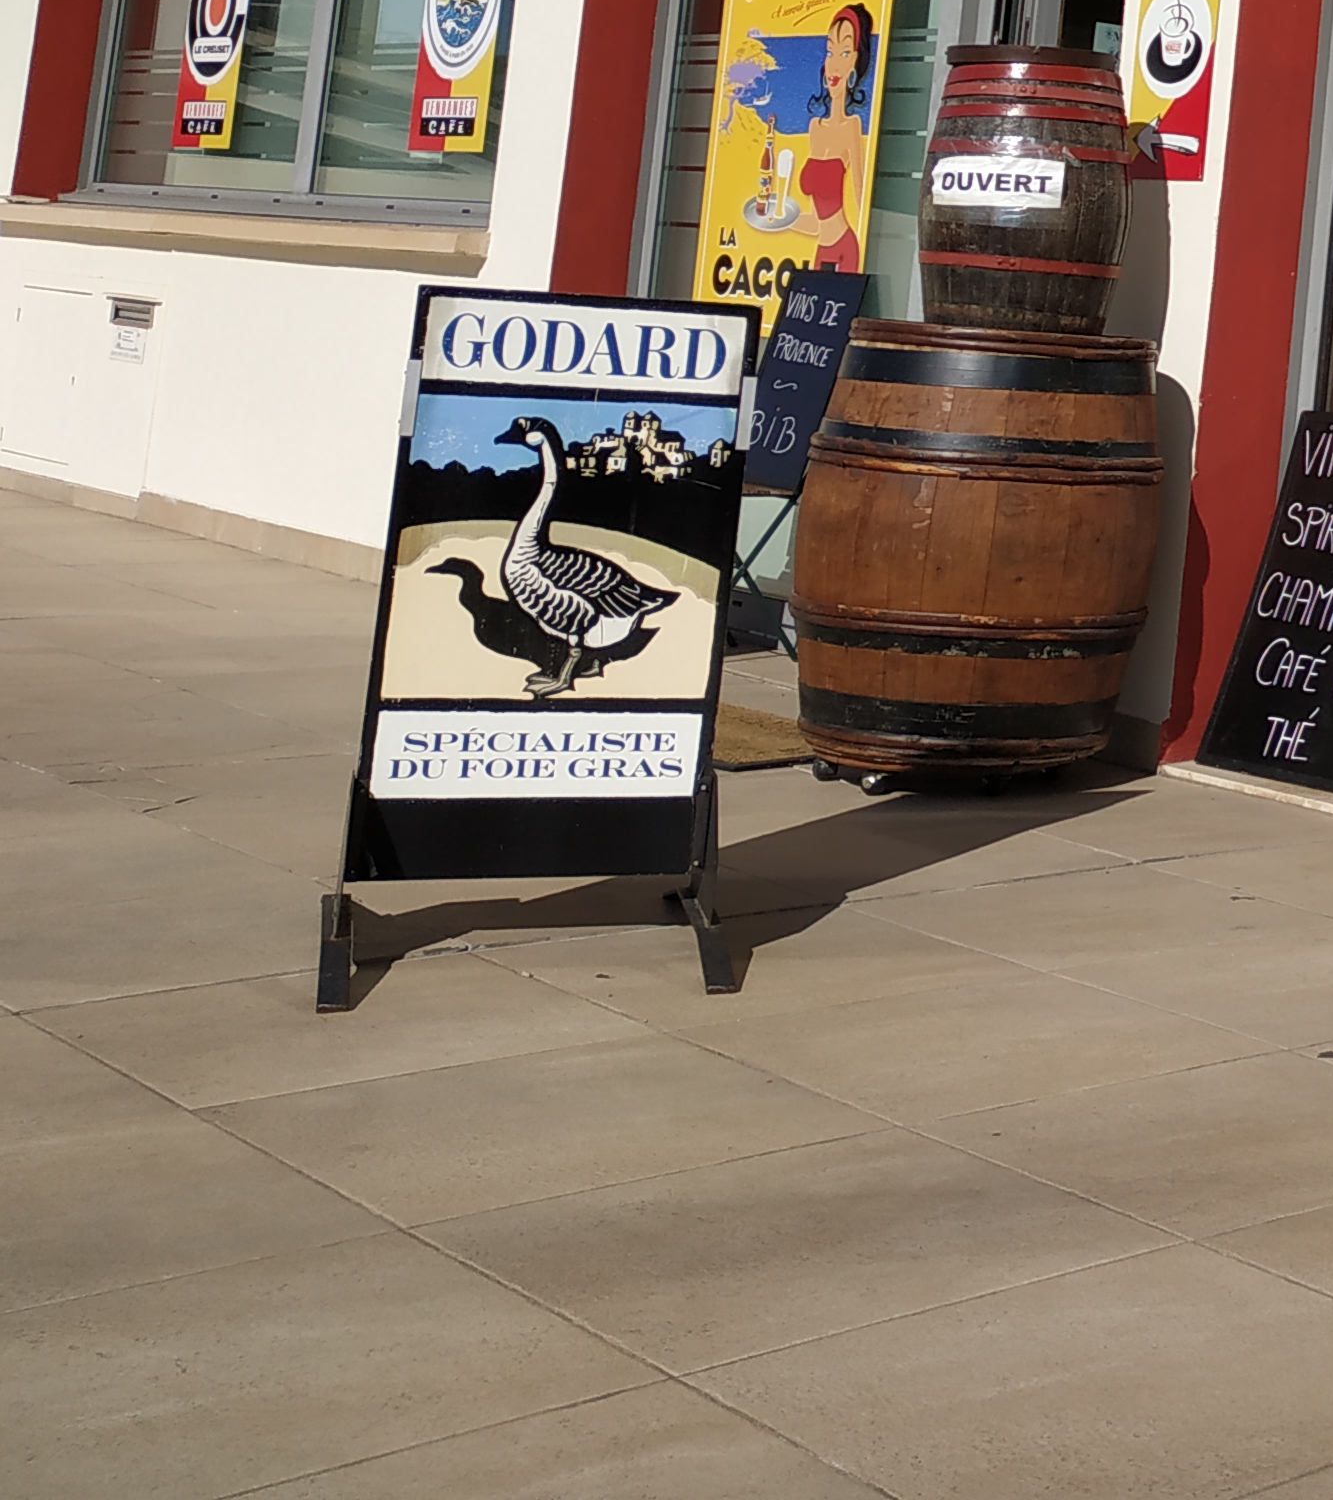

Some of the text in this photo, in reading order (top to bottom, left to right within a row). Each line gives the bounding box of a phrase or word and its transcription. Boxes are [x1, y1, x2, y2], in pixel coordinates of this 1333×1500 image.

[424, 100, 475, 117] VENDANGES
[940, 171, 1054, 195] OUVERT
[719, 227, 737, 247] LA
[819, 299, 846, 327] DE
[442, 311, 728, 381] GODARD
[772, 332, 834, 368] PROVENCE
[1255, 637, 1332, 694] CAFÉ
[403, 727, 677, 754] SPÉCIALISTE
[1262, 707, 1320, 762] THÉ
[388, 757, 684, 780] DU FOIE GRAS
